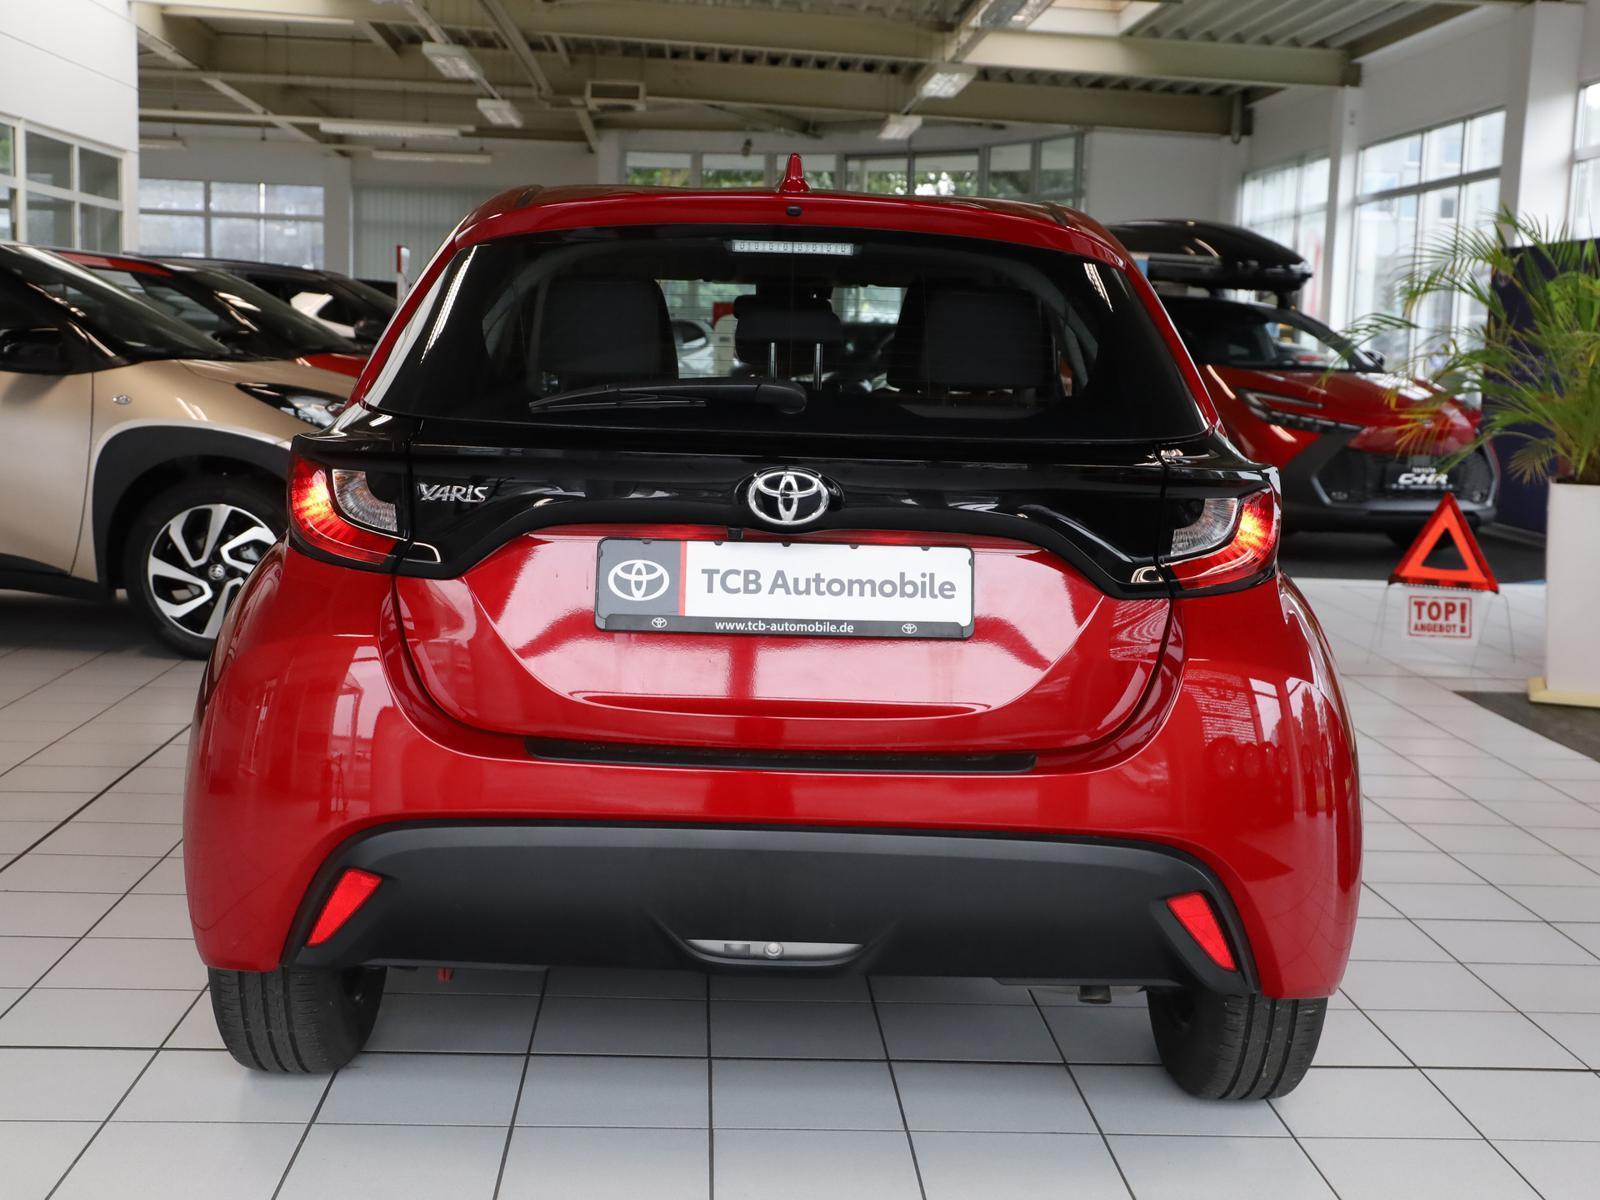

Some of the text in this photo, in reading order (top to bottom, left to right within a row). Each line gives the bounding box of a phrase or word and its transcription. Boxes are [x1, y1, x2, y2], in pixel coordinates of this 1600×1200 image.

[418, 482, 489, 503] YARIS
[701, 568, 957, 600] TCB Automobile
[714, 619, 855, 634] www.tcb-automobile.de
